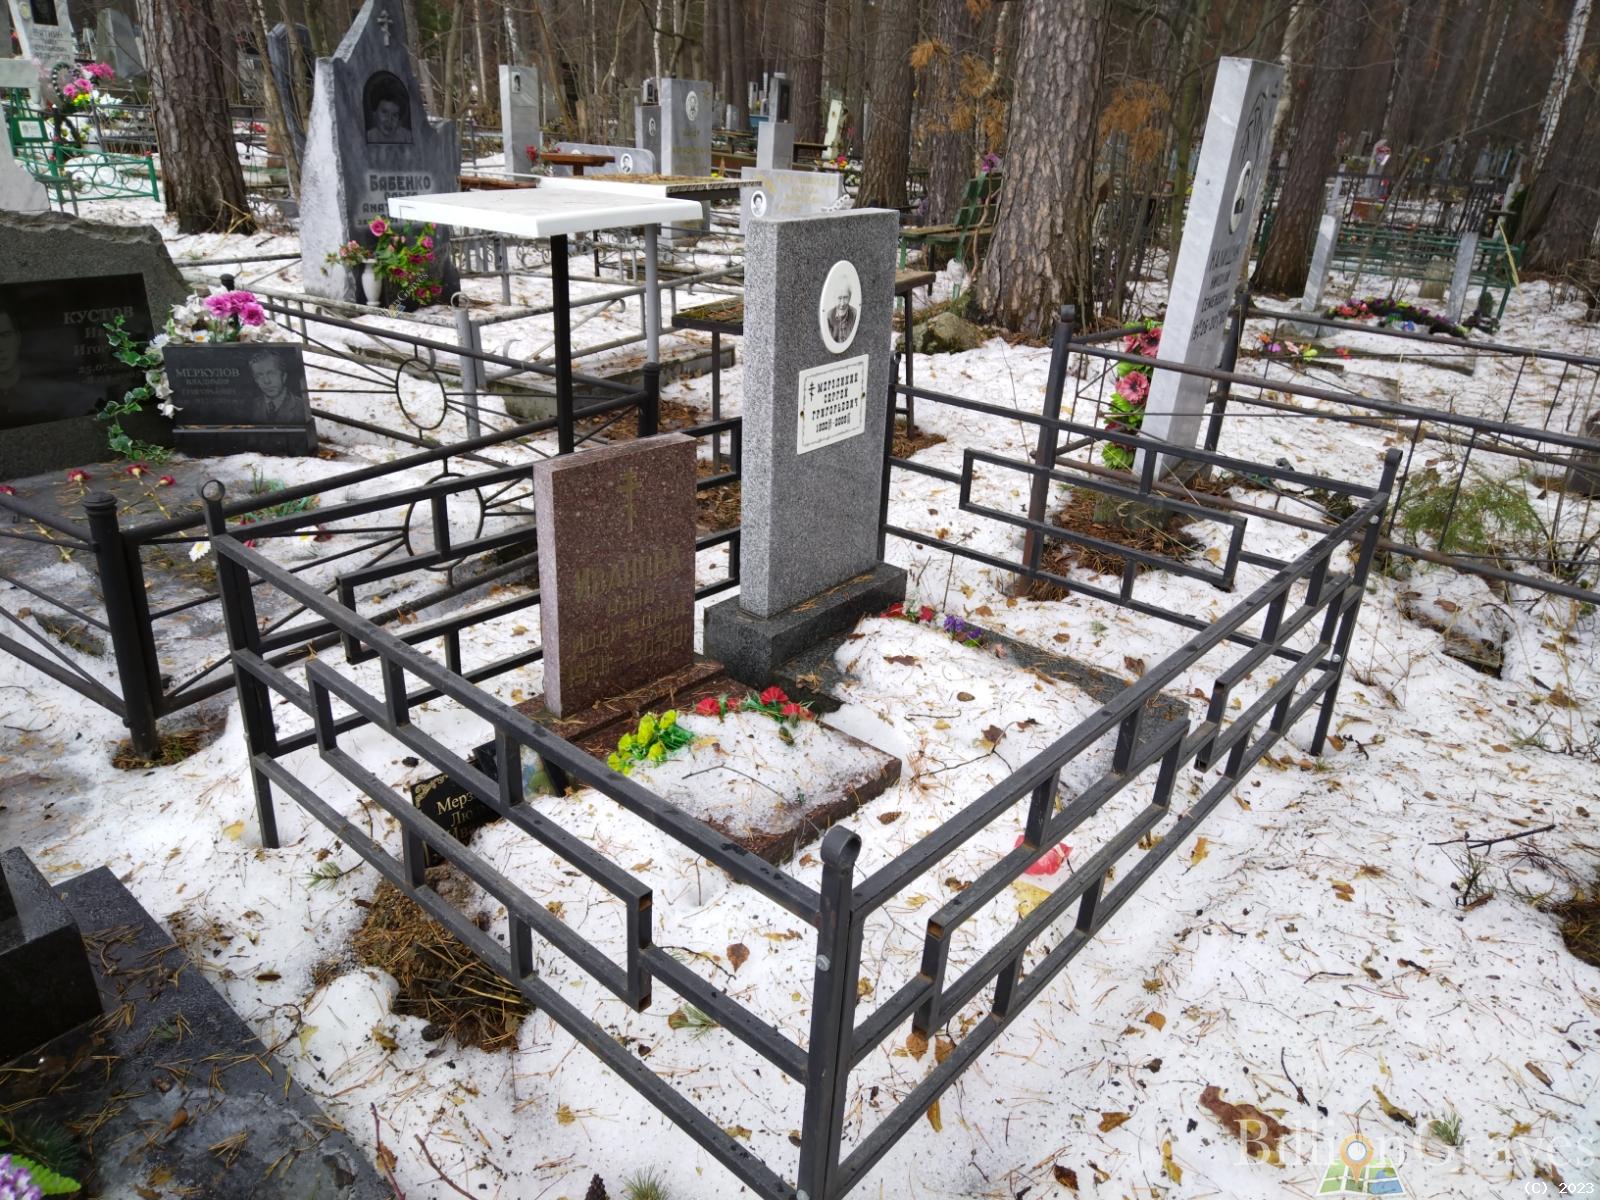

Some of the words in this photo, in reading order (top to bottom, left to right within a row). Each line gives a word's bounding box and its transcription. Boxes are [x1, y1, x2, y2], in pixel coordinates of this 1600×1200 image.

[369, 175, 431, 191] БАБЕНКО
[63, 305, 134, 325] КУСТОВ
[175, 368, 240, 378] МЕРКУЛОВ
[823, 386, 849, 404] СЕРГЕЙ
[811, 397, 859, 421] ГРИГОРЬЕВИЧ
[575, 544, 681, 604] ИВАНОВА
